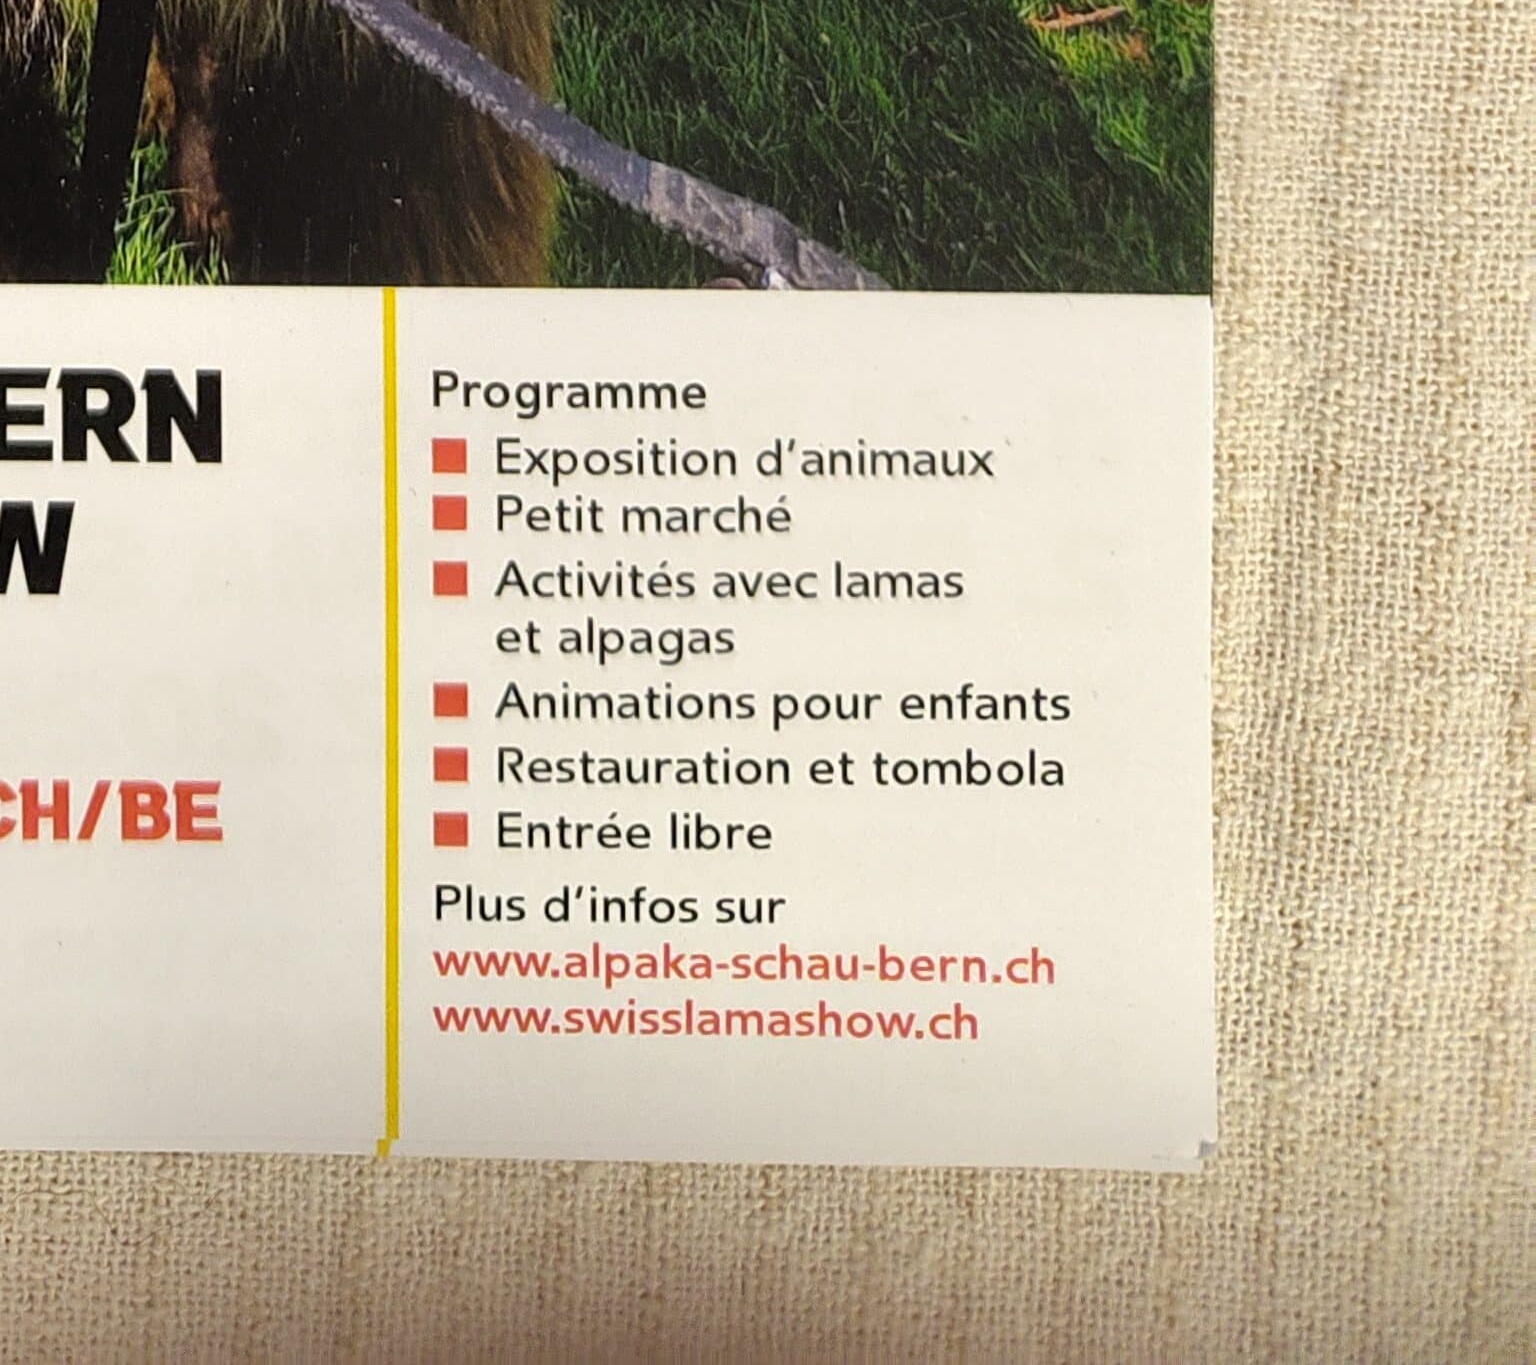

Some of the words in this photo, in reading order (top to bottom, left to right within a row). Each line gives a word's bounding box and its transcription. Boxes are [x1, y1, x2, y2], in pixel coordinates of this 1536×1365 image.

[432, 370, 707, 420] Programme
[496, 437, 737, 488] Exposition
[497, 494, 604, 534] Petit
[622, 495, 792, 534] marché
[494, 560, 696, 599] Activités
[713, 572, 818, 599] avec
[835, 561, 964, 599] lamas
[496, 621, 541, 655] et
[559, 617, 735, 666] alpagas
[495, 682, 756, 720] Animations
[773, 694, 882, 732] pour
[900, 683, 1070, 722] enfants
[498, 747, 790, 785] Restauration
[809, 752, 855, 786] et
[873, 748, 1064, 787] tombola
[498, 812, 651, 850] Entrée
[670, 812, 772, 850] libre
[435, 884, 526, 922] Plus
[716, 898, 786, 924] sur
[432, 942, 1054, 990] www.alpaka-schau-bern.ch
[433, 998, 978, 1040] www.swisslamashow.ch
